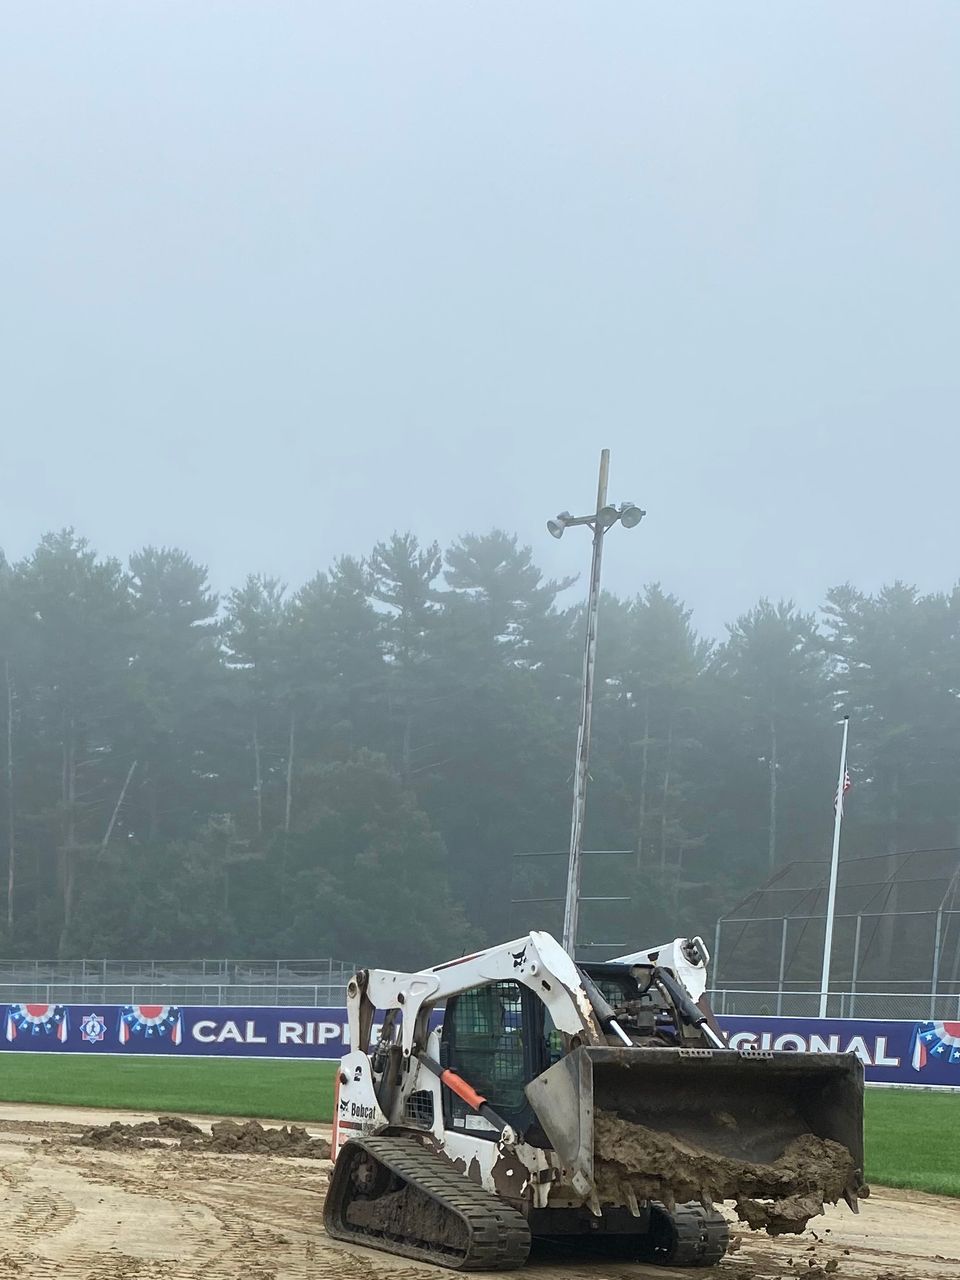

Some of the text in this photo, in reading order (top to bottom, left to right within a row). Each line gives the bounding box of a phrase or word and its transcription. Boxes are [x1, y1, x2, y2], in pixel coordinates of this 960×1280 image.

[192, 1020, 267, 1044] CAL
[722, 1031, 901, 1068] GIONAL
[353, 1065, 363, 1082] 2
[351, 1102, 376, 1120] Bobcat
